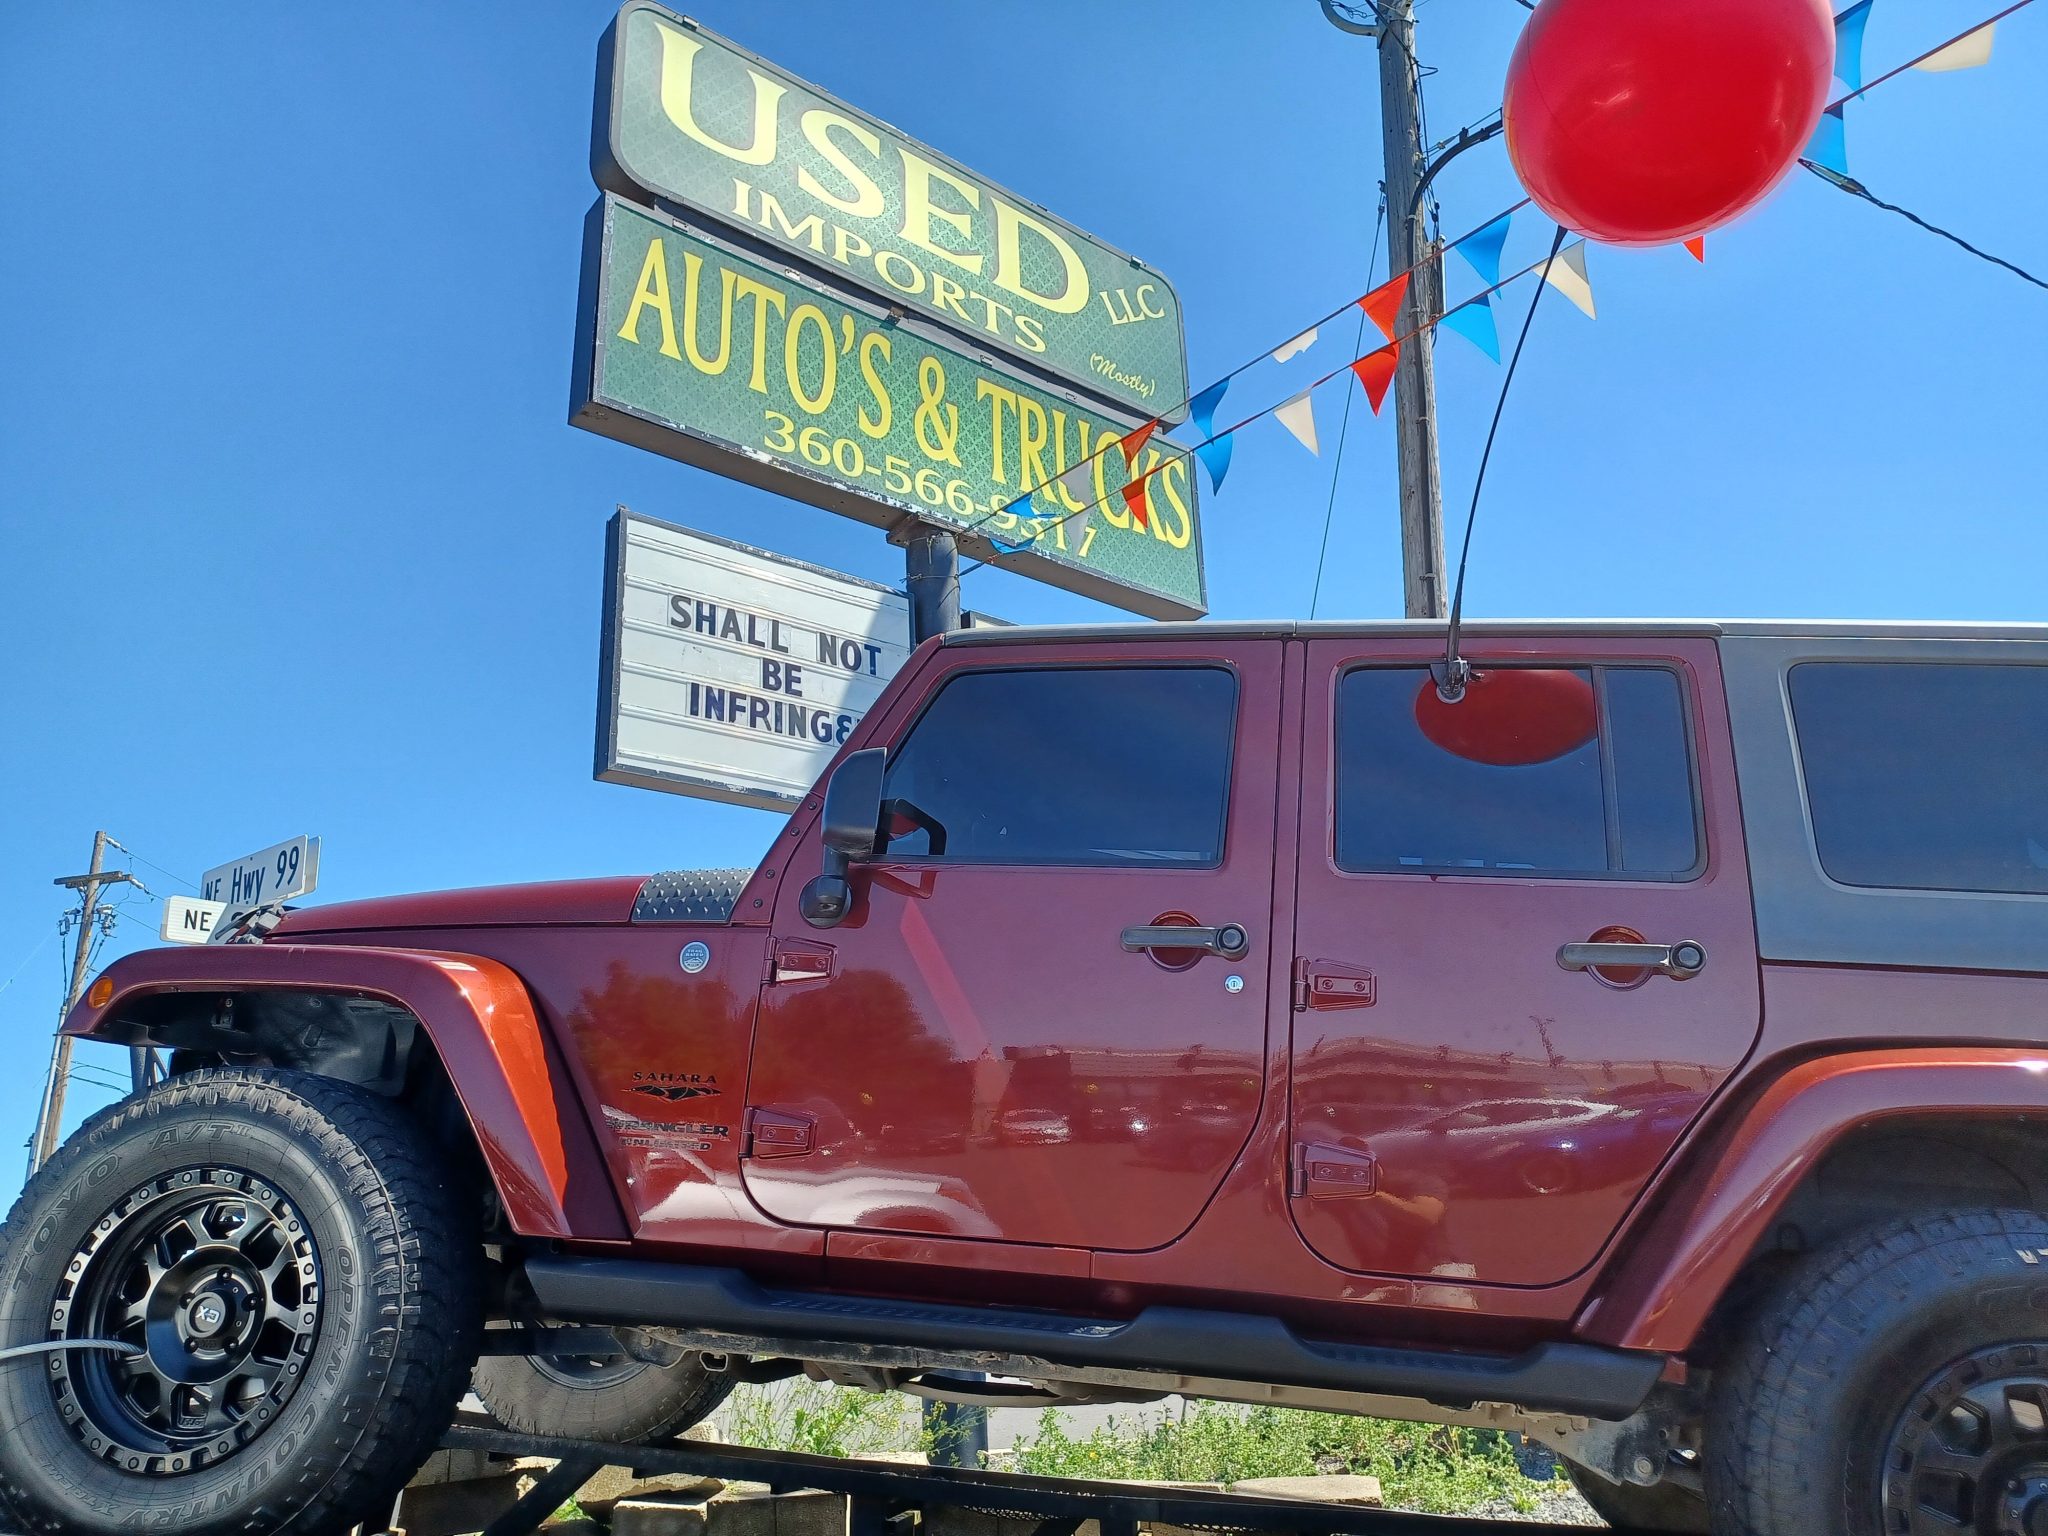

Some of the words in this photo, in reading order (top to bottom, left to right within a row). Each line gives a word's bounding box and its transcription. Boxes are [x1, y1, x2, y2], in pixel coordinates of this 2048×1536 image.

[654, 22, 1091, 315] USED
[732, 178, 1047, 354] IMPORTS
[1099, 283, 1166, 327] LLC
[616, 237, 894, 441] AUTO'S
[913, 355, 963, 469] &
[976, 377, 1192, 550] TRUCKS
[1089, 351, 1157, 400] (Mostly)
[669, 594, 790, 654] SHALL
[818, 632, 882, 676] NOT
[689, 681, 862, 746] INFRINGE
[762, 659, 803, 697] BE
[230, 865, 266, 906] Hwy
[275, 845, 300, 890] 99
[184, 908, 212, 932] NE
[631, 1071, 717, 1084] SAHARA
[13, 1151, 121, 1295] TOYO
[322, 1245, 360, 1384] OPEN
[118, 1400, 319, 1530] COUNTRY
